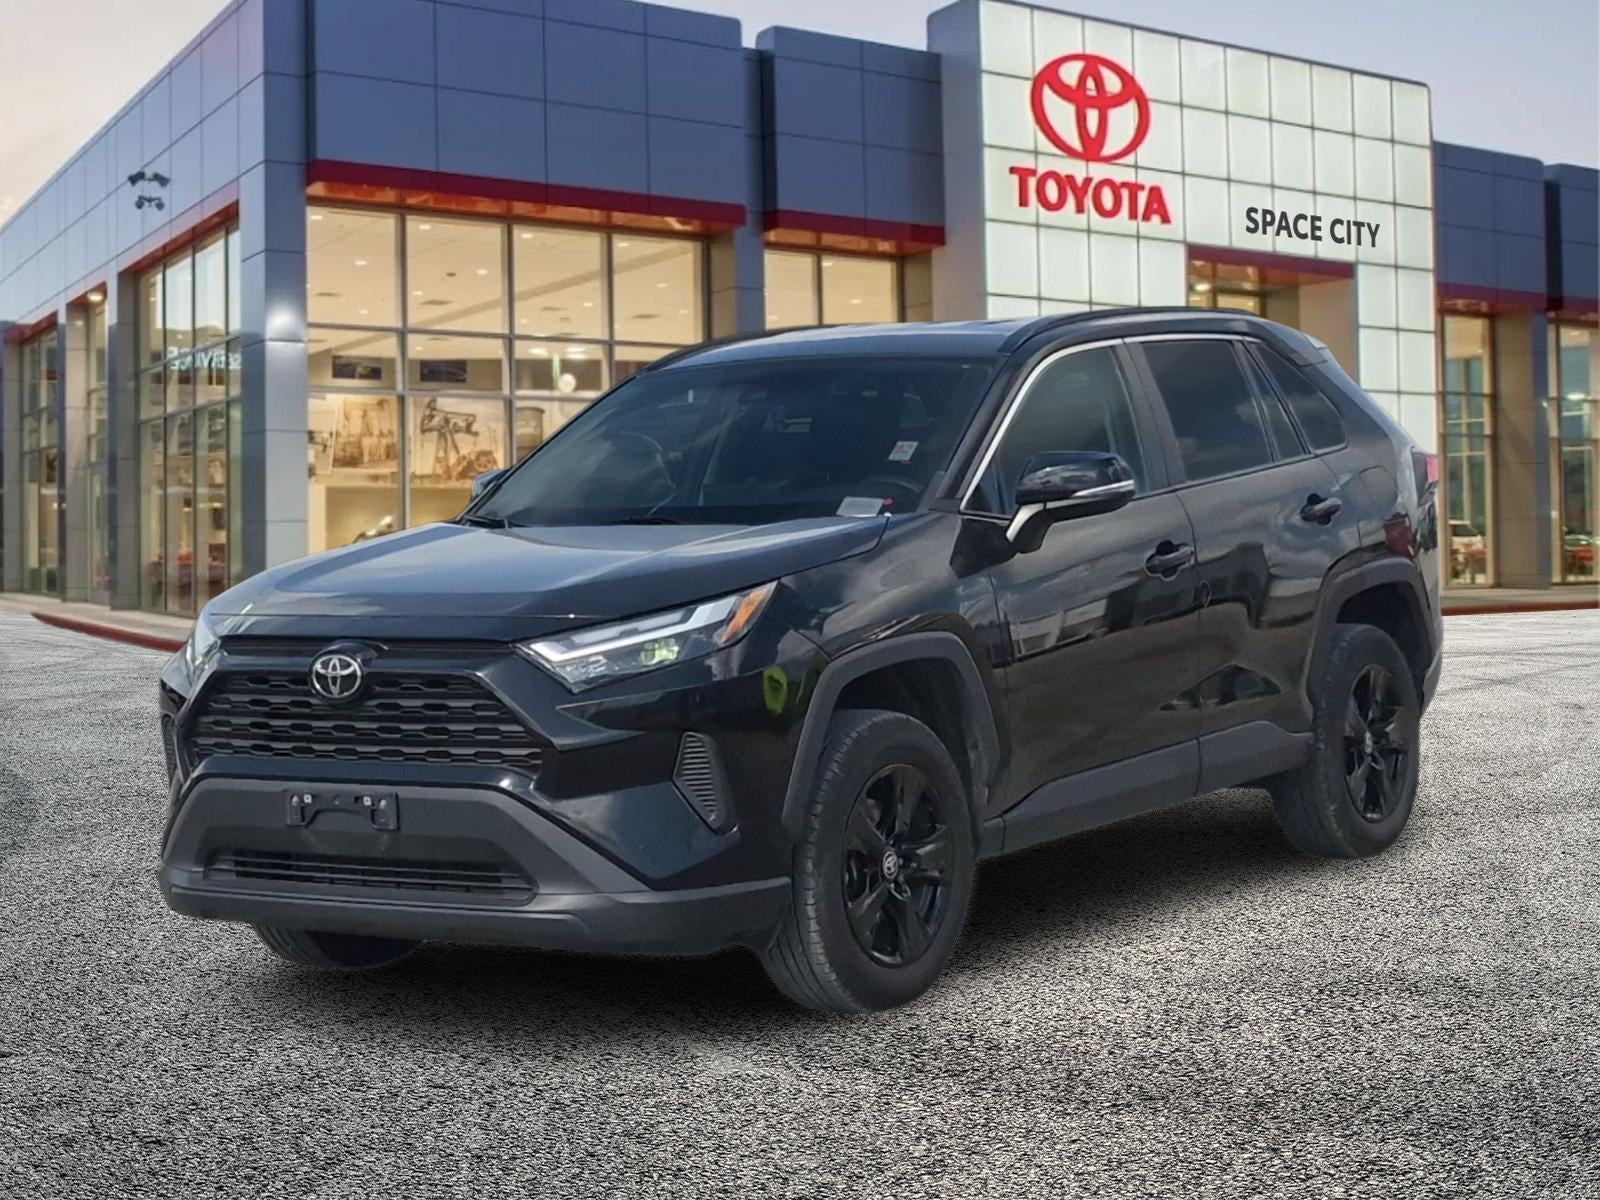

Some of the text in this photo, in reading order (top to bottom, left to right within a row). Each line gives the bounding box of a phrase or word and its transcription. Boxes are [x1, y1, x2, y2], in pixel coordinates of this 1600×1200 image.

[1009, 166, 1171, 224] TOYOTA
[1245, 207, 1380, 248] SPACE CITY
